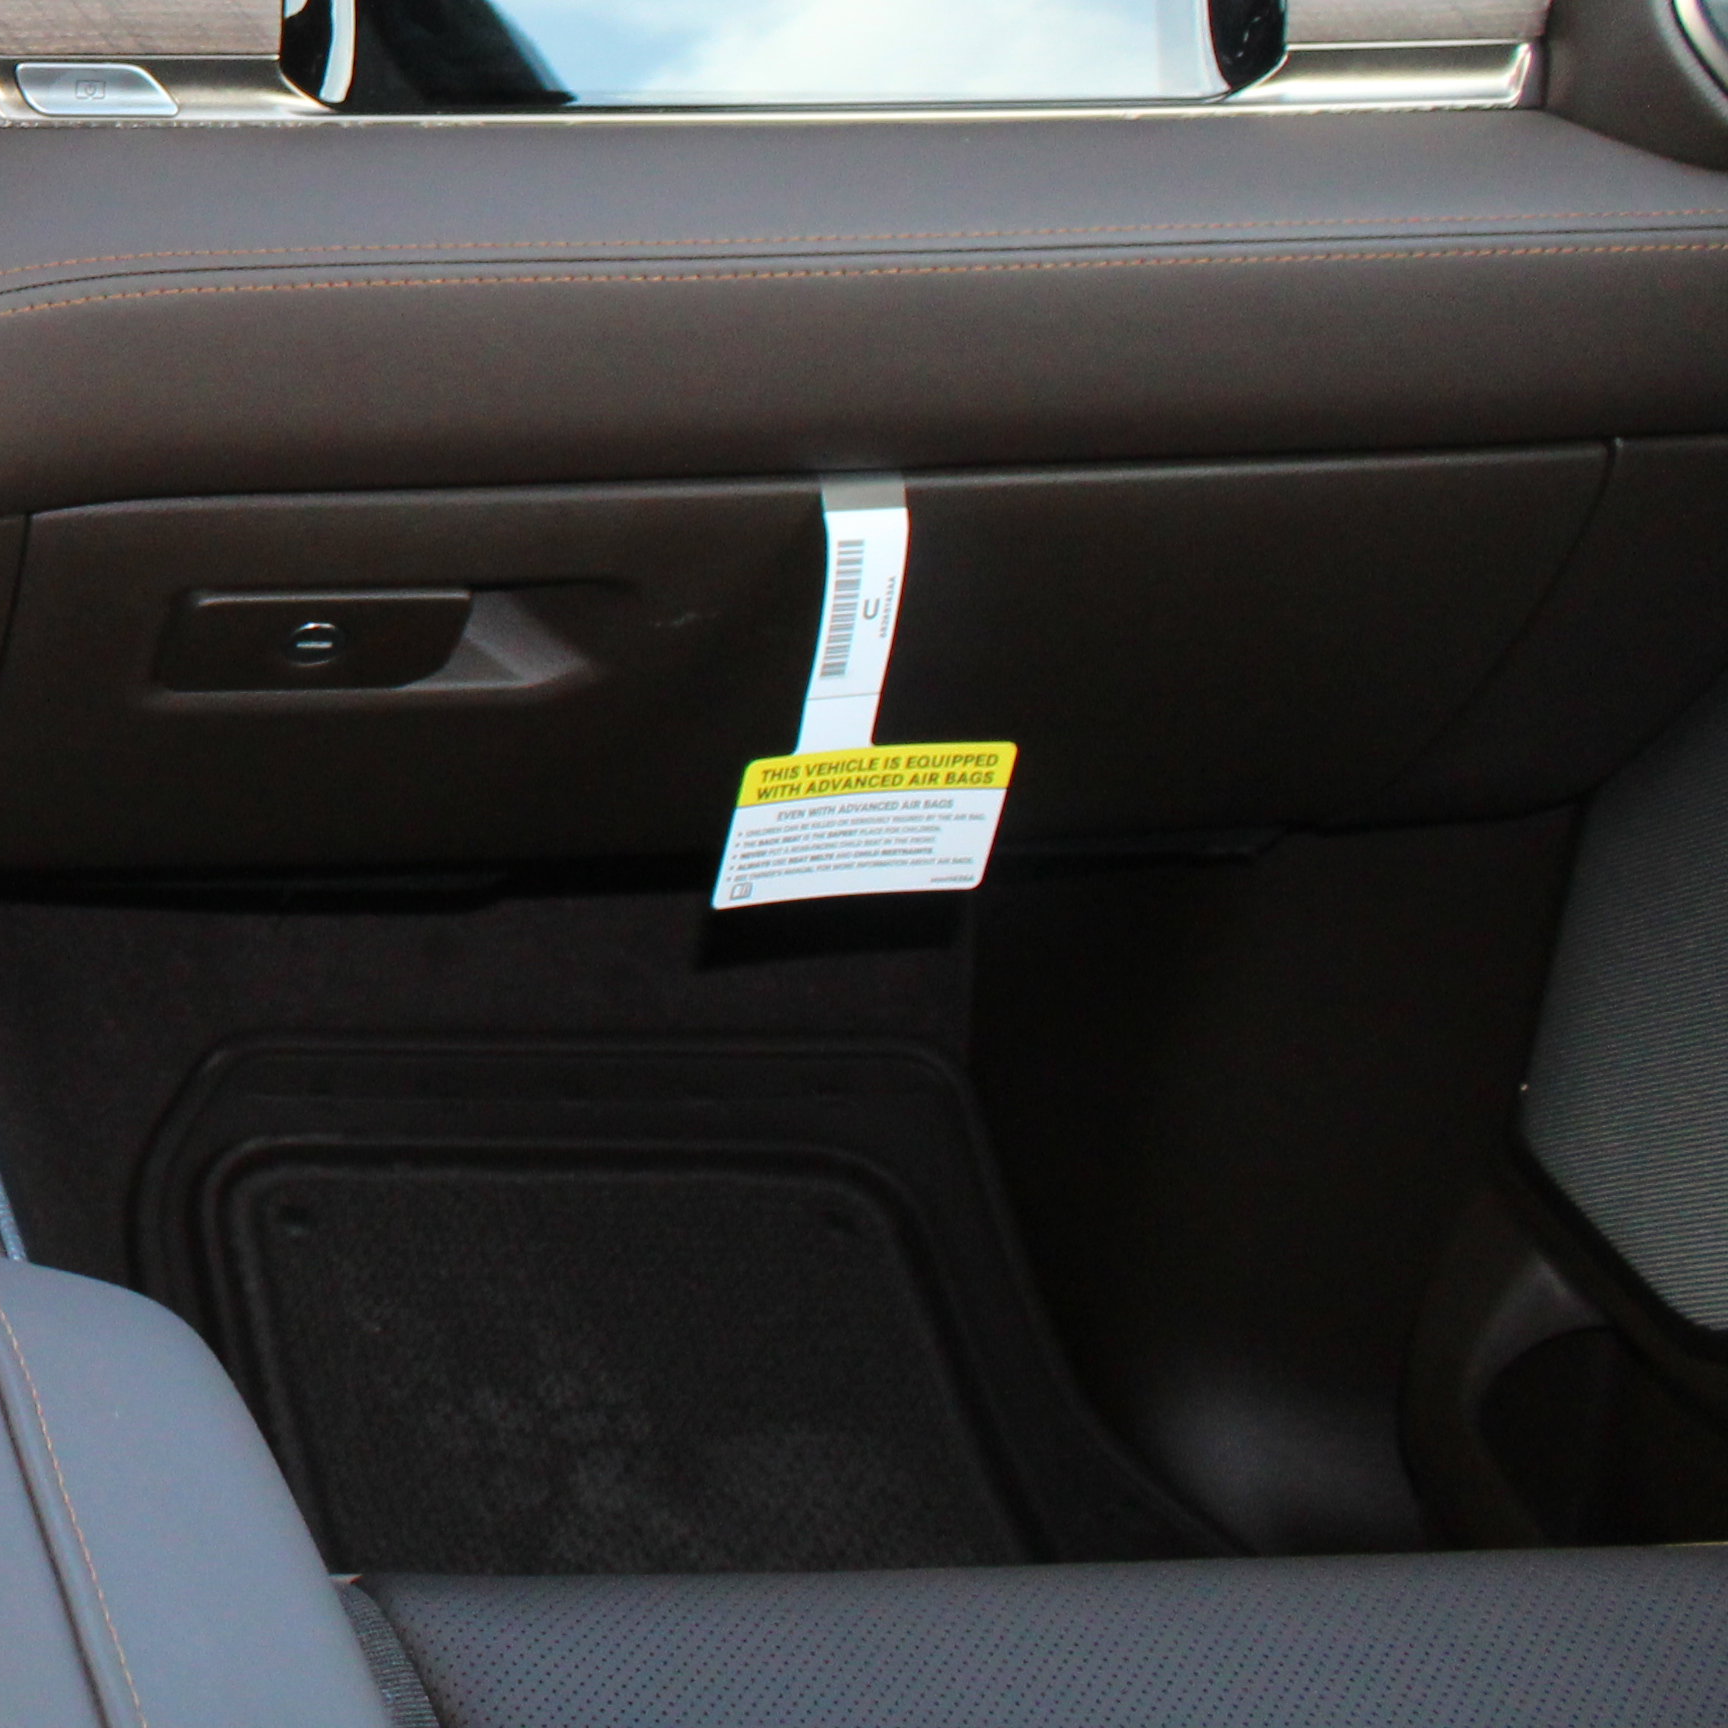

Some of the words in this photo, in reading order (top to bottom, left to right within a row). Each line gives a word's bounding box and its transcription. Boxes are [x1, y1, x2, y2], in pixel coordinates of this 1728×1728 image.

[761, 768, 800, 783] THIS
[805, 760, 879, 777] VEHICLE
[883, 756, 900, 769] IS
[906, 754, 999, 769] EQUIPPED
[756, 786, 801, 801] WITH
[805, 774, 904, 795] ADVANCED
[908, 773, 939, 785] AIR
[944, 771, 994, 785] BAGS
[777, 809, 805, 822] EVEN
[808, 805, 836, 817] WITH
[838, 800, 900, 815] ADVANCED
[902, 799, 921, 809] AIR
[923, 798, 954, 809] BAGS
